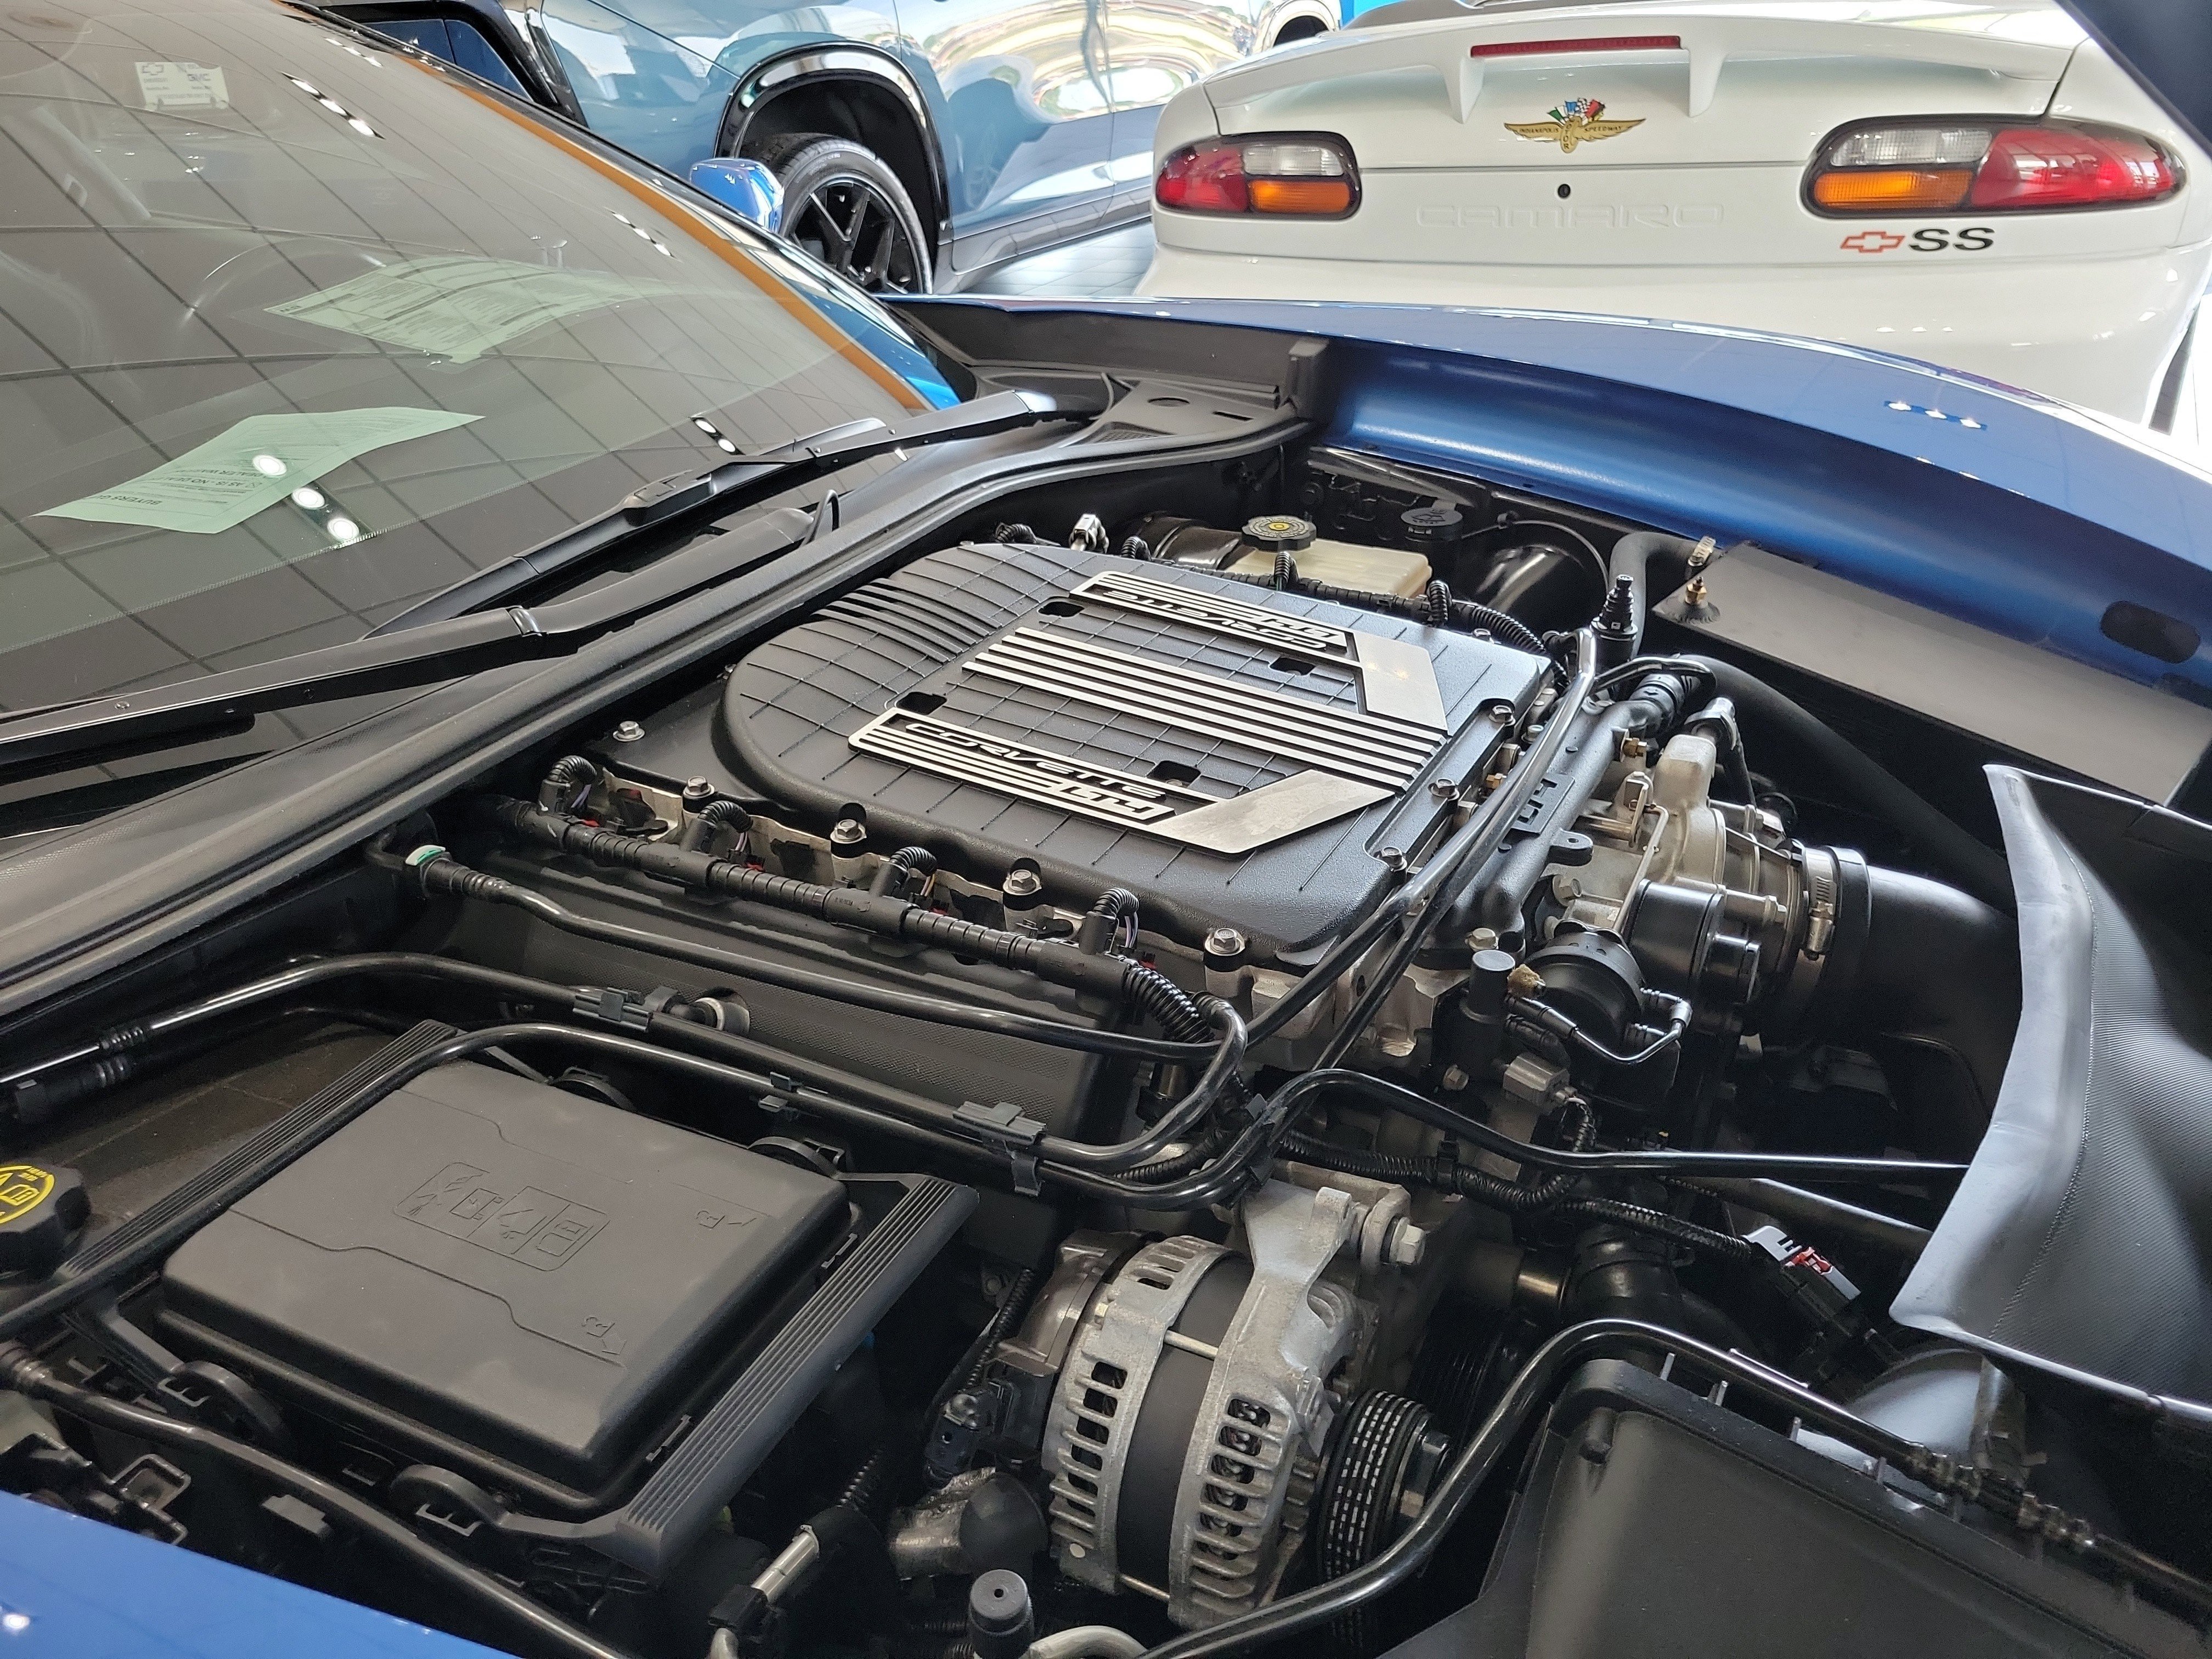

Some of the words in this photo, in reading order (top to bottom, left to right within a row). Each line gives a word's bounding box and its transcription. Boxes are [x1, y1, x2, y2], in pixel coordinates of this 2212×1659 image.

[1416, 203, 1724, 229] CAMARO
[1908, 227, 1995, 252] SS
[111, 495, 163, 505] BUYERS
[1102, 589, 1327, 650] CORVETTE
[905, 723, 1167, 799] CORVETTE
